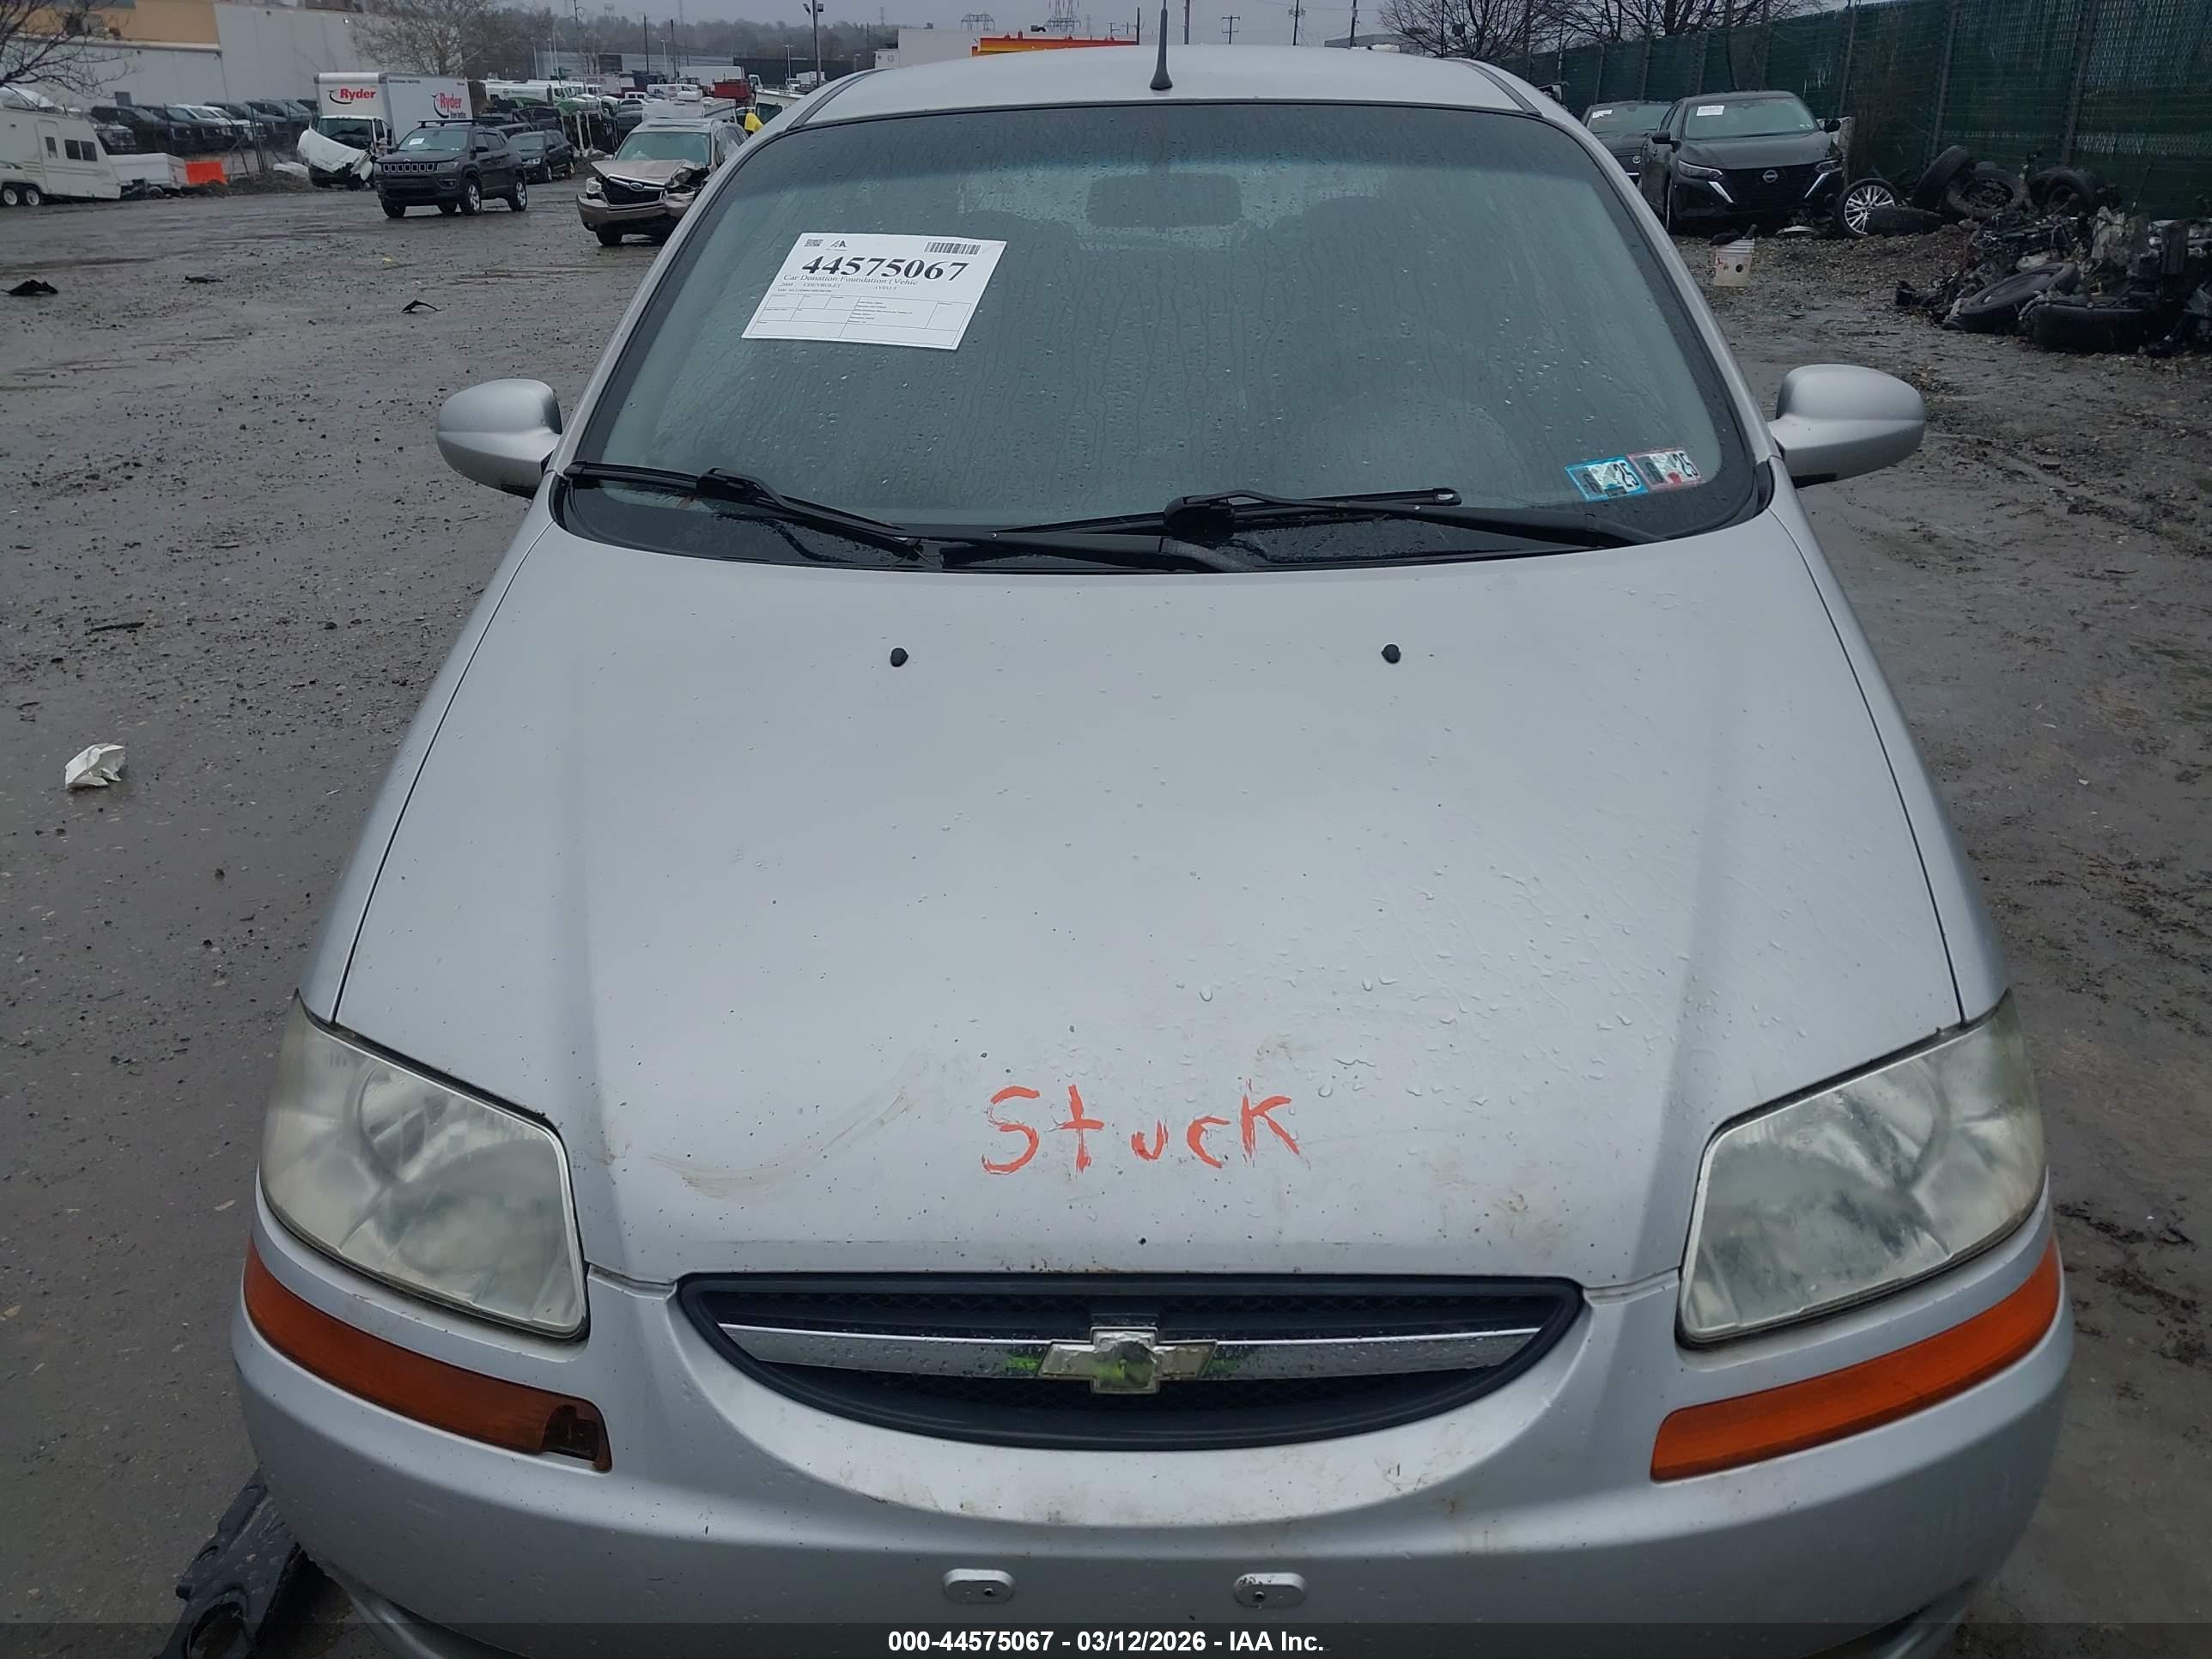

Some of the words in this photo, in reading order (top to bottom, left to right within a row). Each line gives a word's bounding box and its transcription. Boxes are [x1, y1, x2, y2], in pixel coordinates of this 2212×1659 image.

[340, 88, 376, 100] Ryder
[440, 93, 462, 112] Ryder
[801, 255, 969, 281] 44575067
[840, 276, 886, 284] Foundation
[889, 277, 918, 286] (Vehic
[1613, 462, 1639, 488] 25
[1673, 453, 1698, 477] 25
